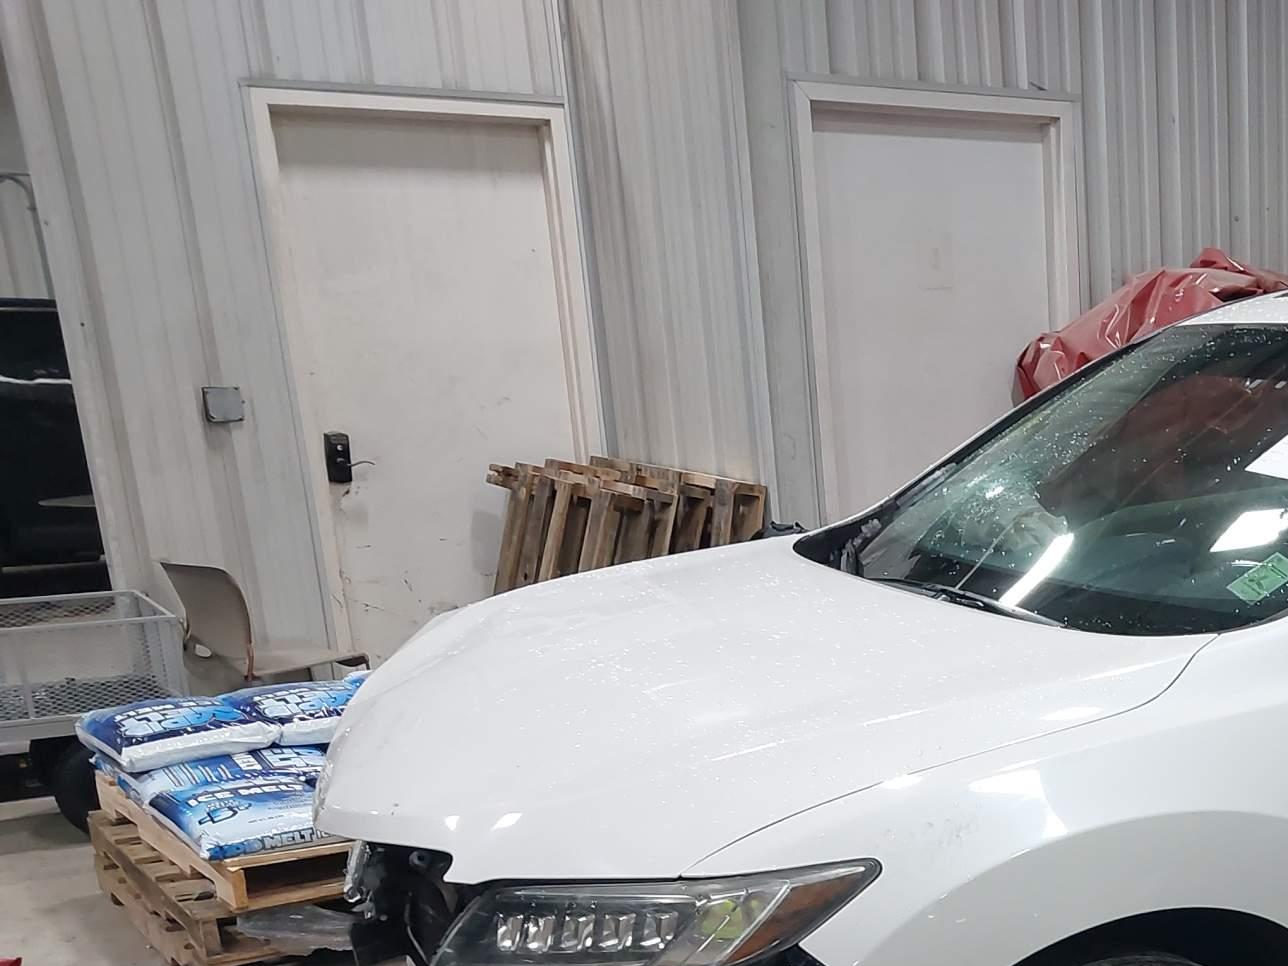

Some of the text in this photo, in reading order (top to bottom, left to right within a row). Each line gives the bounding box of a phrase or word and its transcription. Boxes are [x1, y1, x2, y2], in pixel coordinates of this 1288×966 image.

[186, 783, 304, 808] ICE MELT
[262, 827, 315, 850] MELT
